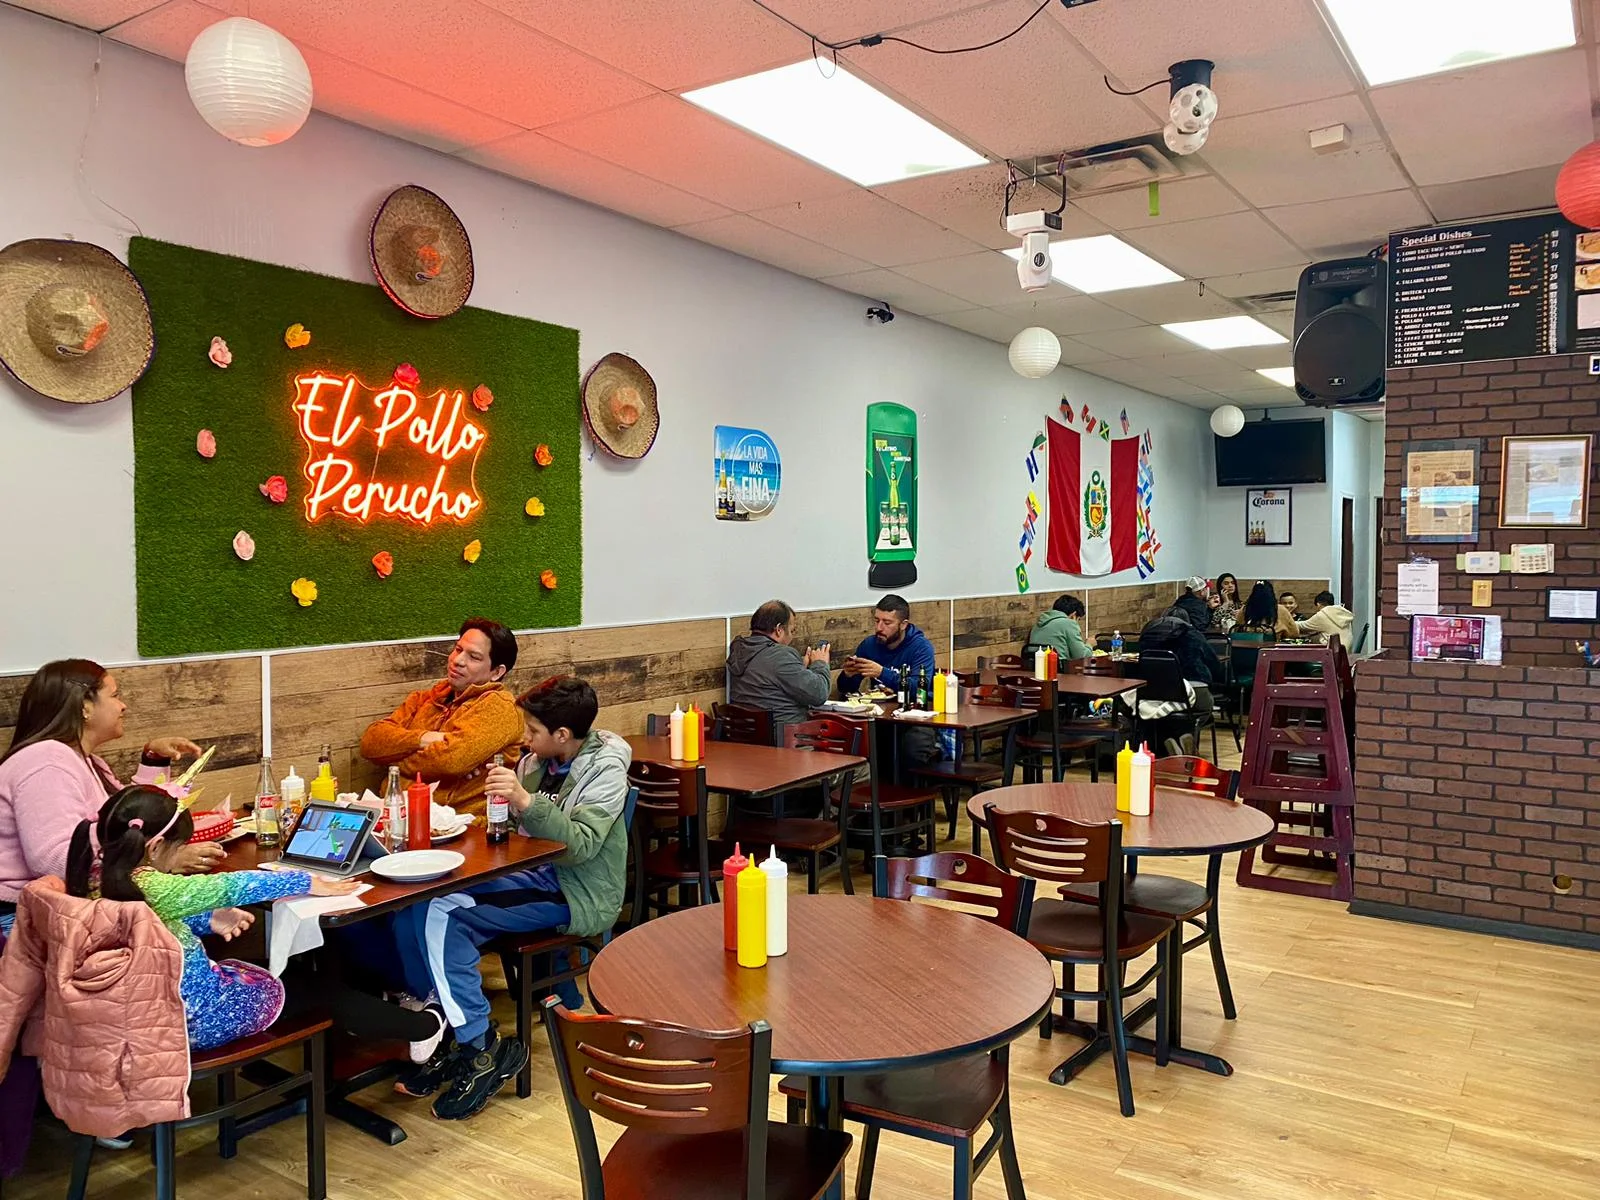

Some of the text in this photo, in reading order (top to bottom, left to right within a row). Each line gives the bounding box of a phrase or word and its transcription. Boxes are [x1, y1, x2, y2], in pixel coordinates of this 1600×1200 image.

[1402, 231, 1472, 246] Special Dishes
[1580, 267, 1587, 275] 6
[298, 374, 485, 460] El Pollo
[743, 445, 768, 460] LA VIDA
[749, 461, 763, 475] MAS
[308, 453, 479, 523] Perucho
[742, 476, 770, 501] FINA
[1253, 497, 1285, 507] Corona
